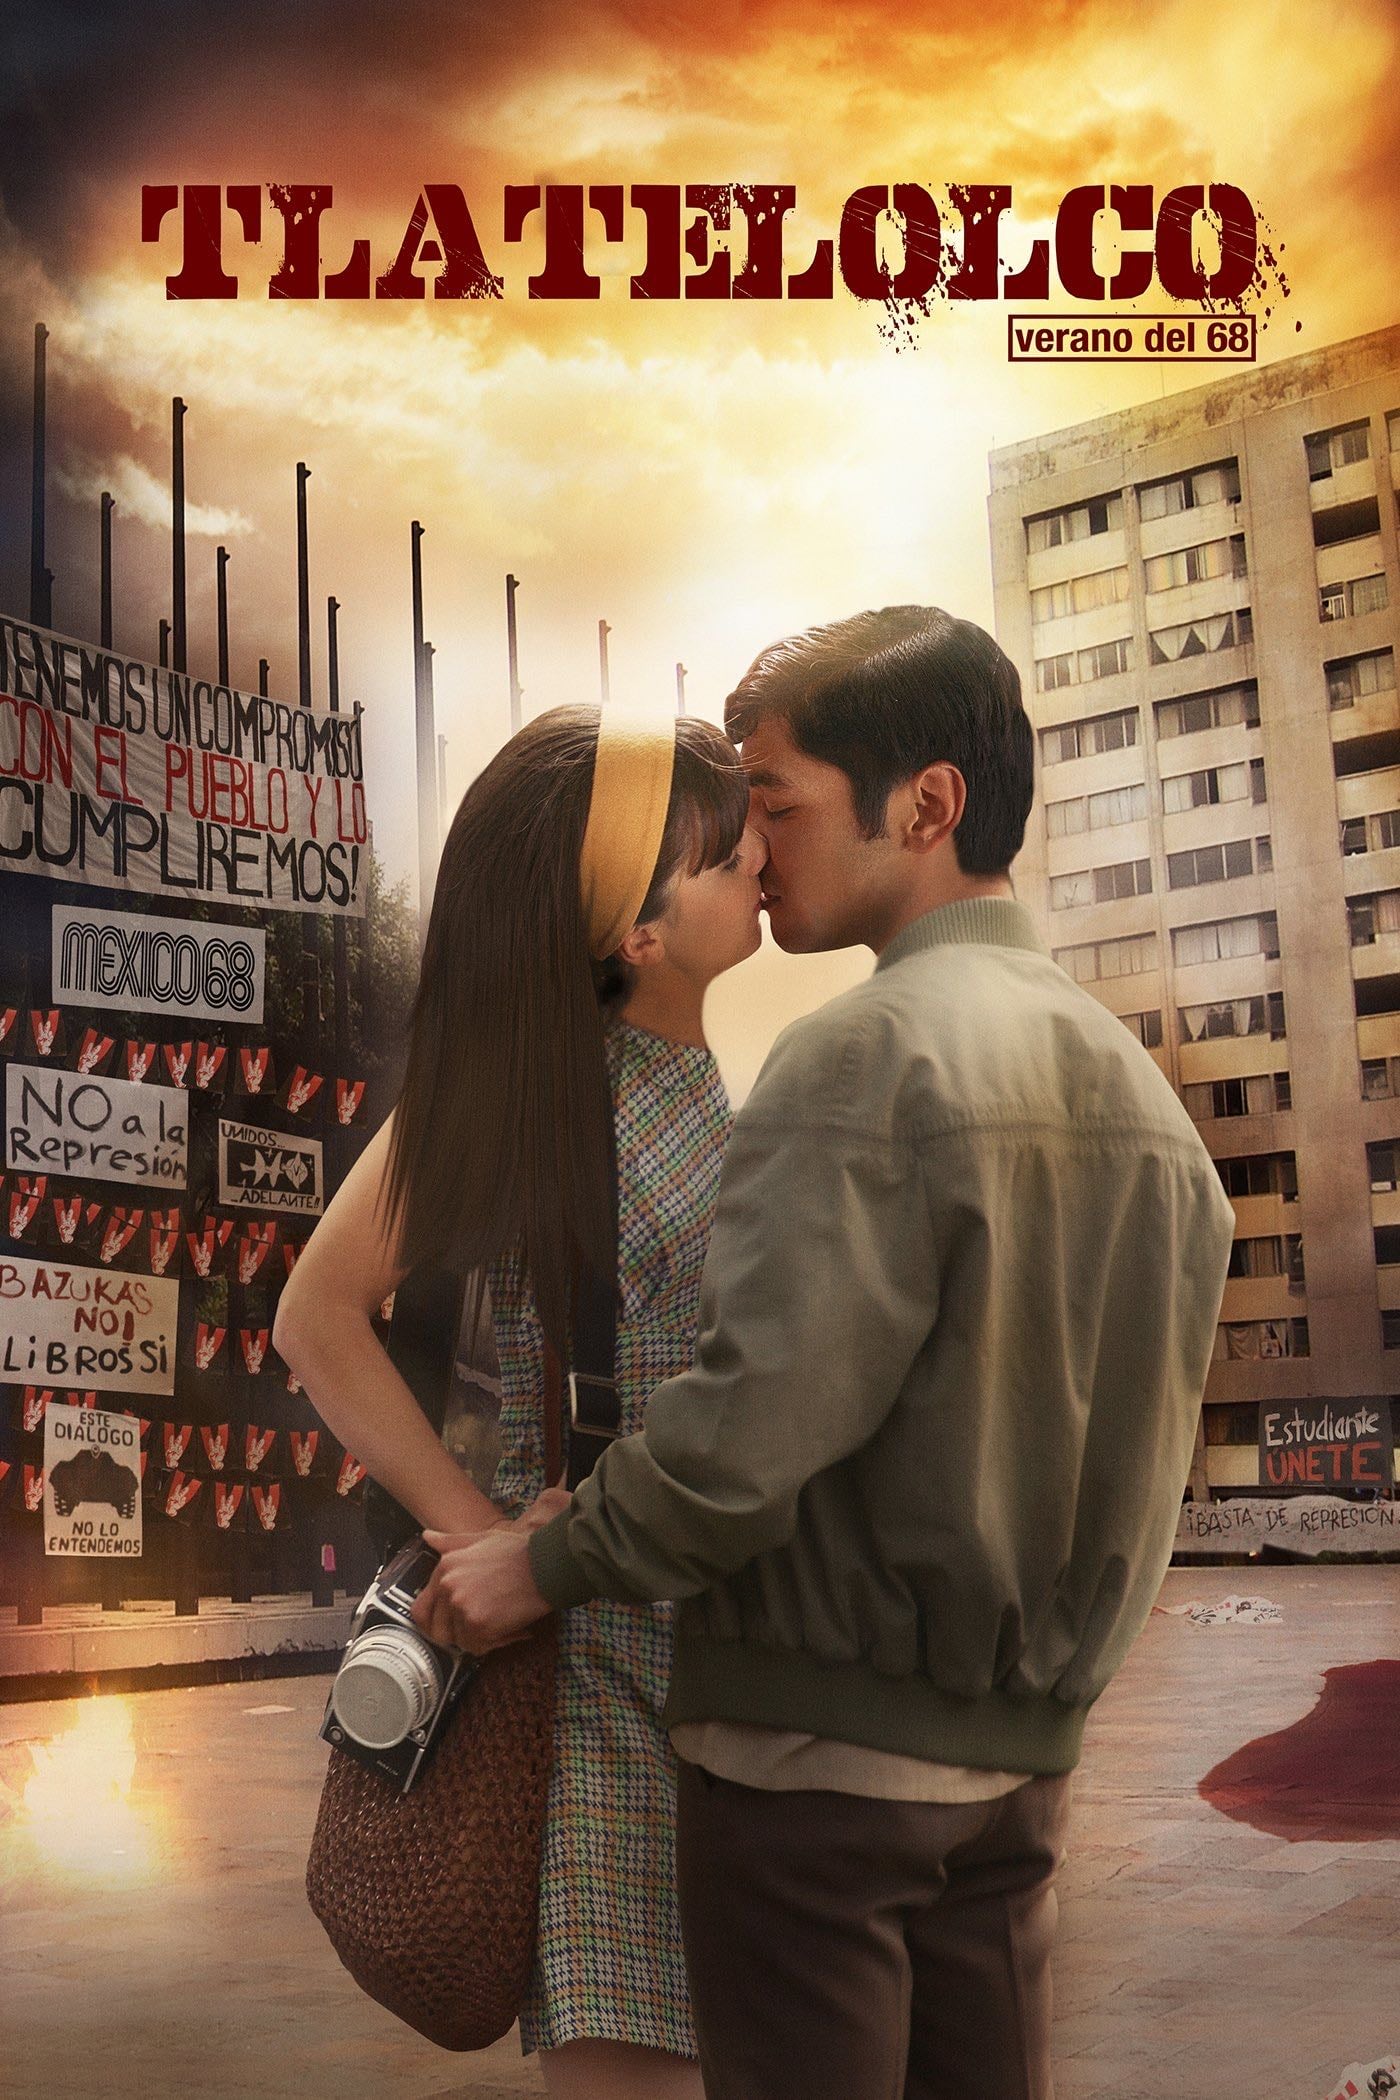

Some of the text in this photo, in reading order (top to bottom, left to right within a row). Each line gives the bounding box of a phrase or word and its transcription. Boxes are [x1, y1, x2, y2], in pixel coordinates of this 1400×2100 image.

[0, 694, 367, 844] CON EL PUEBLO Y LO
[0, 776, 359, 906] CUMPLIREMOS!
[60, 921, 255, 1012] MEXICO 68
[22, 1075, 185, 1146] NO a la
[10, 1127, 187, 1182] Represión
[0, 1264, 153, 1315] BAZUKAS
[55, 1422, 134, 1447] DIALOGO
[80, 1412, 111, 1428] ESTE
[1264, 1403, 1380, 1447] Estudiante
[72, 1521, 119, 1537] NO LO
[1266, 1506, 1288, 1532] DE
[49, 1536, 140, 1554] ENTENDEMOS
